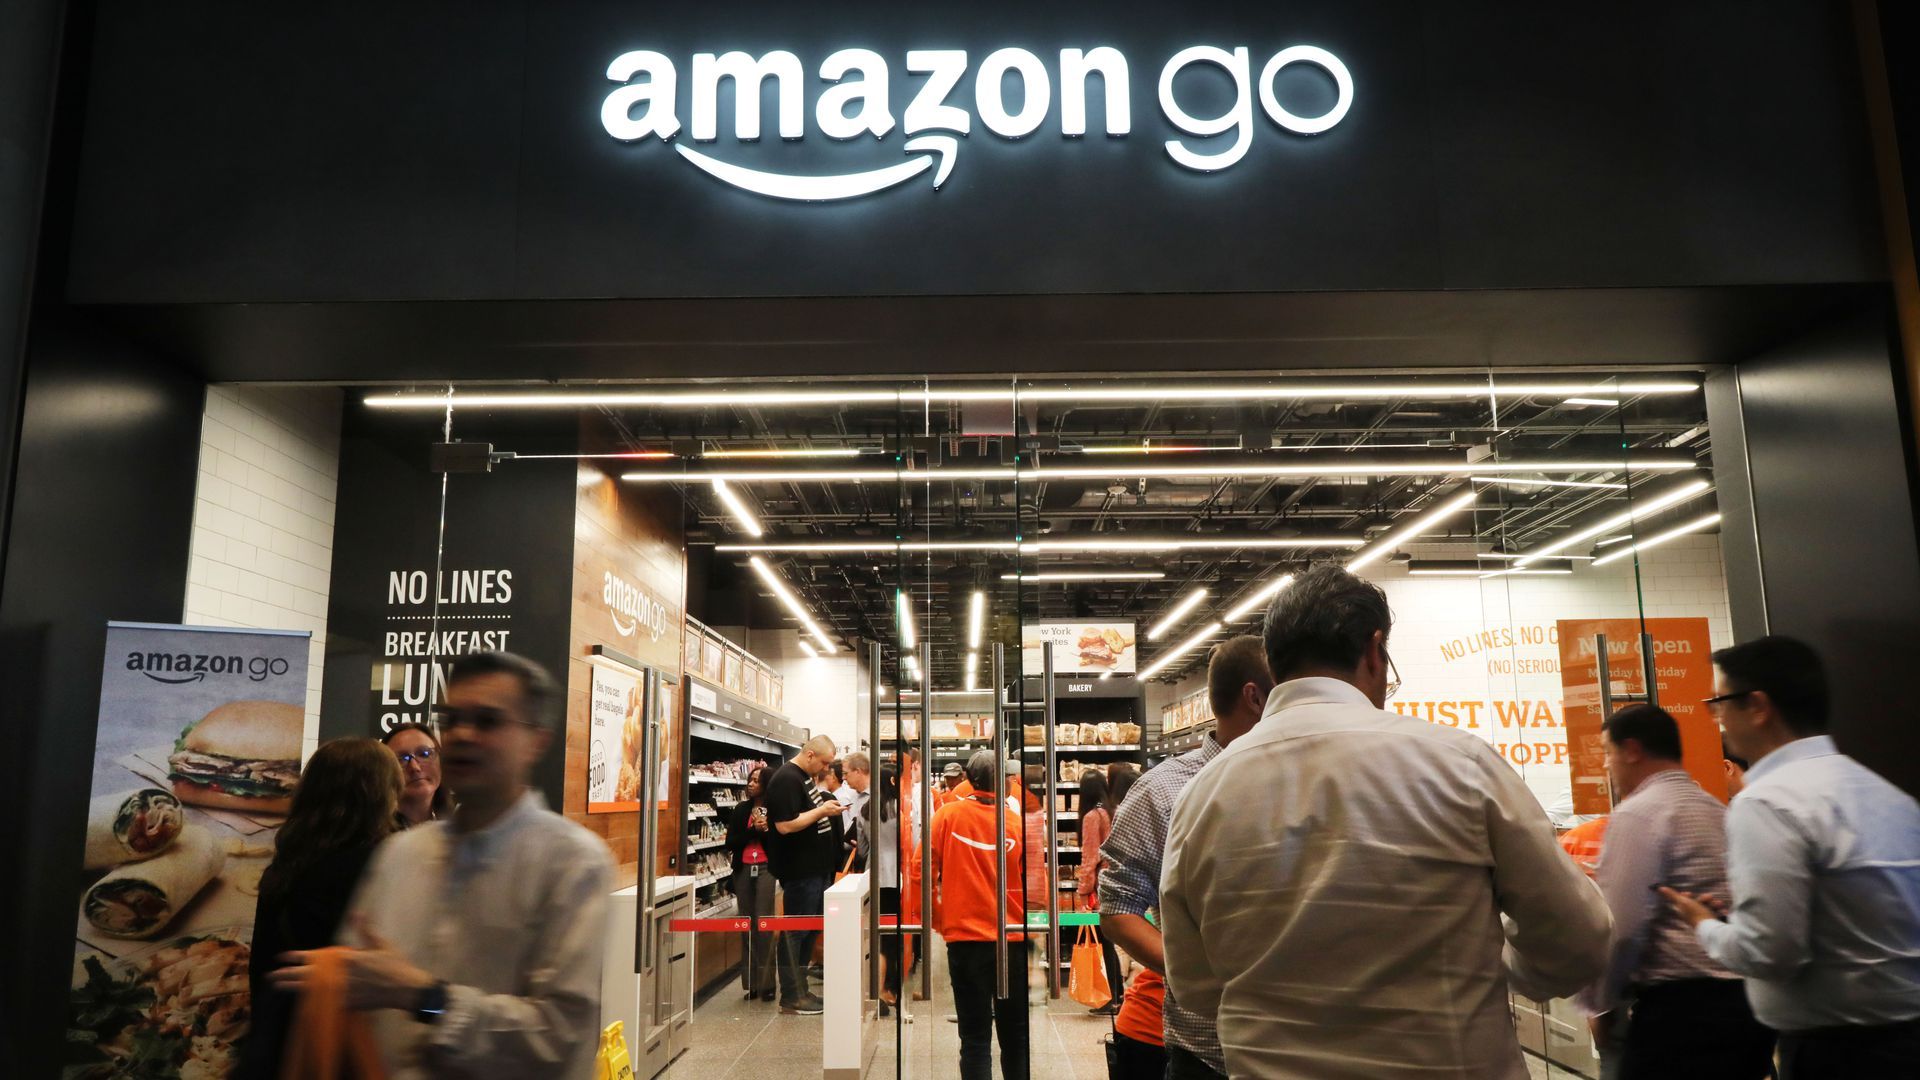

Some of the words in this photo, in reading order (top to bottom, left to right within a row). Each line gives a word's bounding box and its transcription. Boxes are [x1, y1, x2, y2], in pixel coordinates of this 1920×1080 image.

[600, 45, 1131, 143] amazon
[1158, 44, 1354, 171] go
[388, 570, 428, 605] NO
[437, 569, 513, 604] LINES
[604, 570, 650, 628] amazon
[651, 601, 666, 643] go
[385, 630, 511, 657] BREAKFAST
[1051, 627, 1072, 636] York
[1440, 639, 1466, 662] NO
[1520, 625, 1544, 645] NO
[1577, 637, 1630, 655] Nw
[126, 651, 243, 674] amazon
[248, 656, 289, 682] go
[1588, 667, 1633, 679] Mnday
[1655, 667, 1687, 679] riday
[1068, 684, 1093, 693] BAKERY
